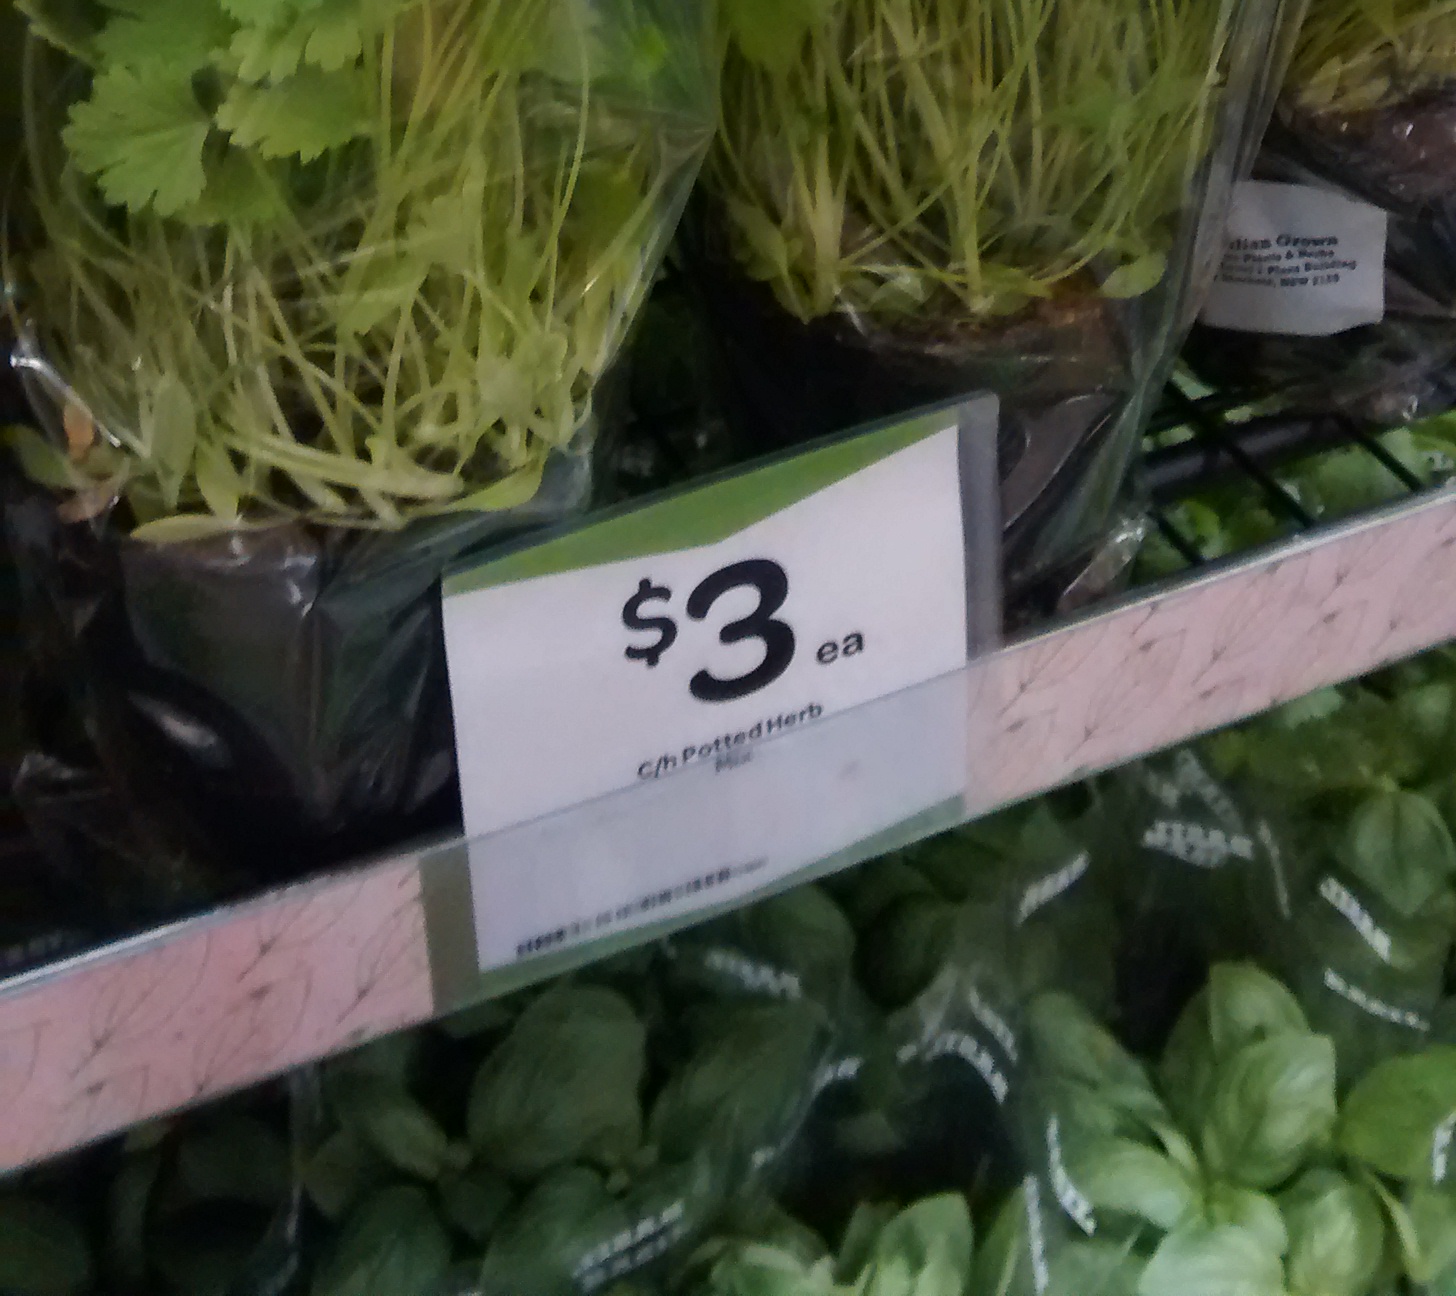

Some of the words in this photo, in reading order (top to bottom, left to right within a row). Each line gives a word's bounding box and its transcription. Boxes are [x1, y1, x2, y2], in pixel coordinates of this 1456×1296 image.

[622, 559, 795, 702] $3
[816, 631, 864, 665] ea
[637, 755, 678, 780] C/h
[682, 720, 763, 764] Potted
[765, 702, 824, 735] Herb
